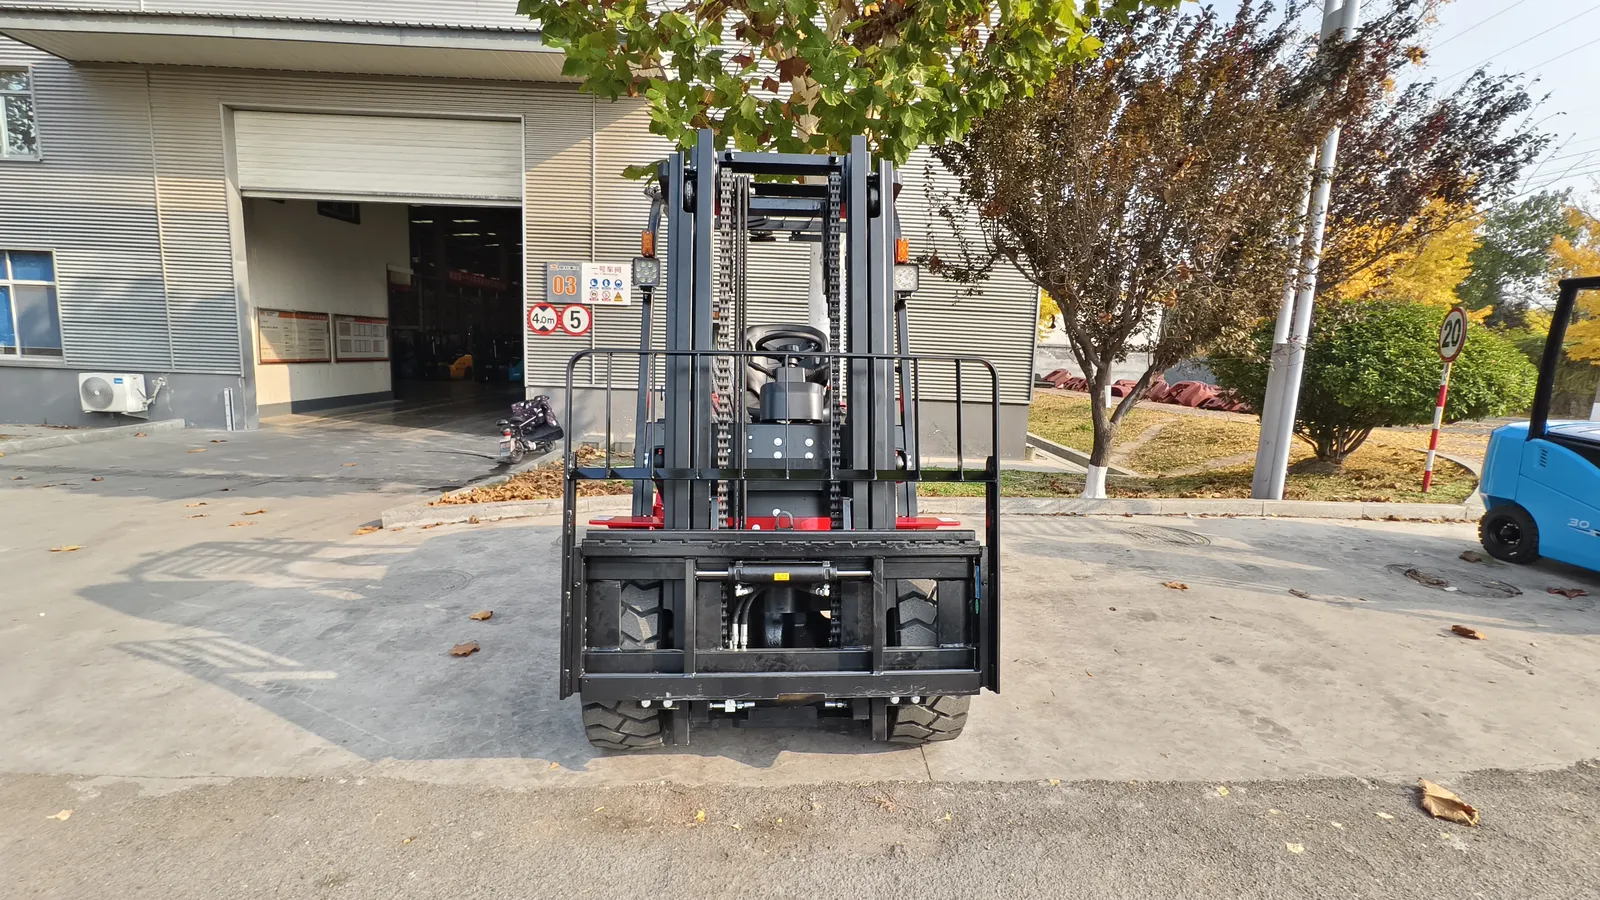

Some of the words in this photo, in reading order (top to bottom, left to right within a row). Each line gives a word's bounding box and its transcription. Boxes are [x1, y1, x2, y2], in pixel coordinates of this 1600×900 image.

[553, 275, 577, 295] 03
[532, 313, 555, 324] 4.0m
[570, 310, 581, 329] 5
[1442, 318, 1461, 348] 20
[1567, 518, 1590, 529] 30
